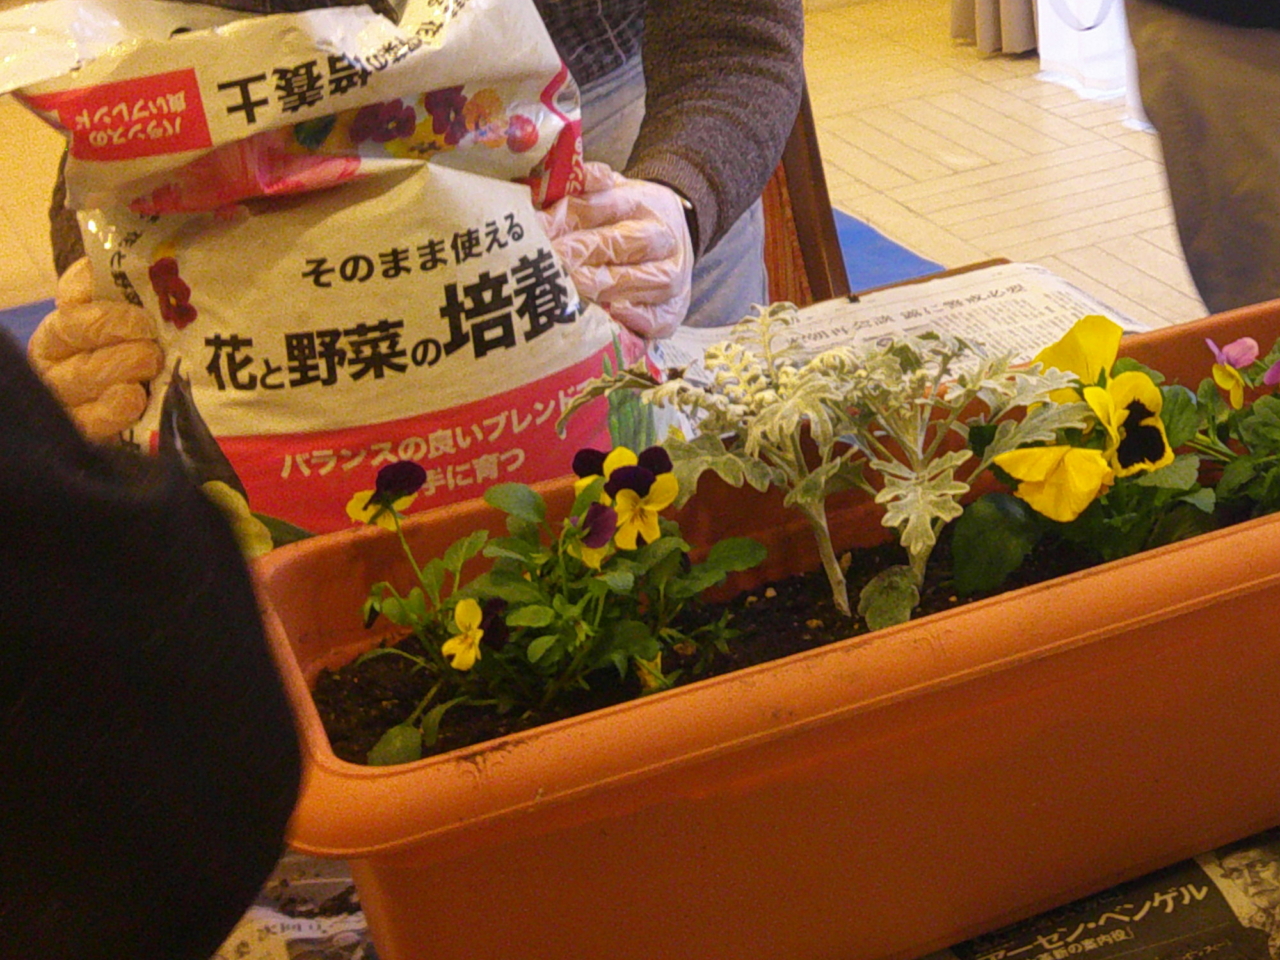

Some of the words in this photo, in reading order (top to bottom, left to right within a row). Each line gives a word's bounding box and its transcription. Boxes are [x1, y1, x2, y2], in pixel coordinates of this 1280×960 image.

[88, 116, 183, 148] バランスの
[301, 212, 525, 288] そのまま使える
[204, 247, 590, 391] 花と野菜の培養
[280, 382, 592, 480] バランスの良いブレンド
[408, 447, 526, 496] 手に育つ
